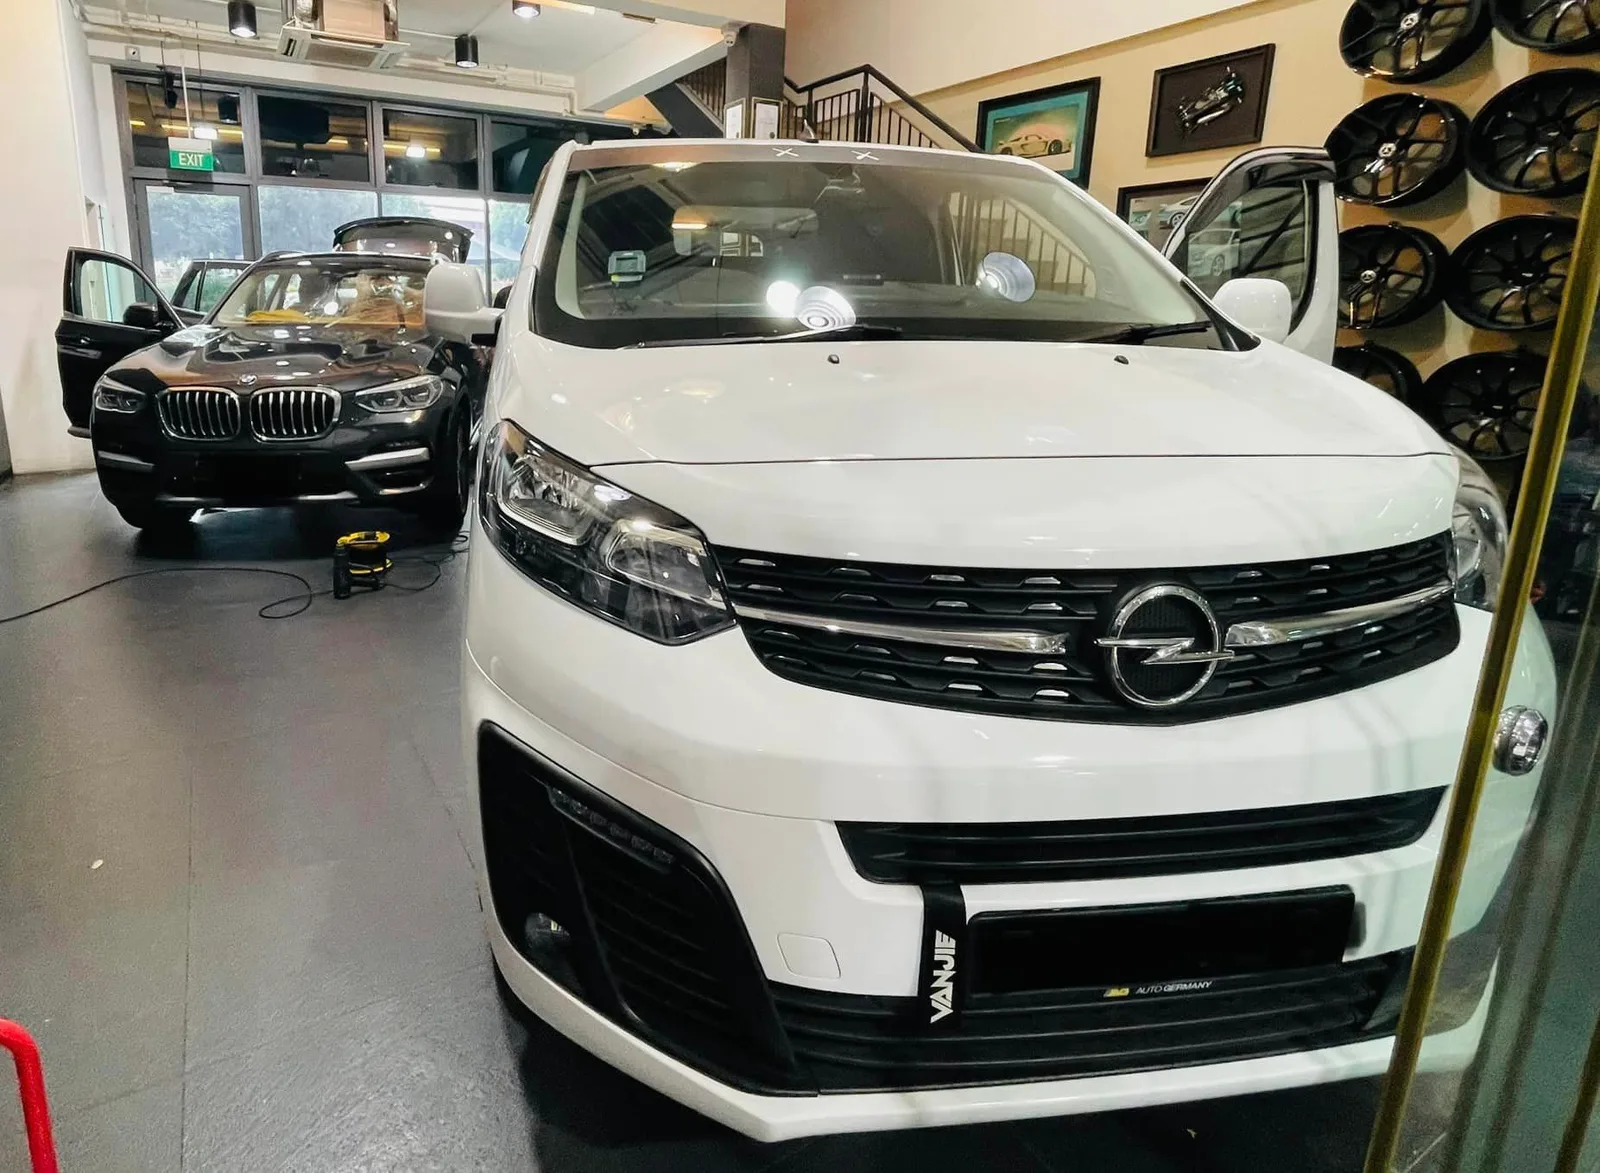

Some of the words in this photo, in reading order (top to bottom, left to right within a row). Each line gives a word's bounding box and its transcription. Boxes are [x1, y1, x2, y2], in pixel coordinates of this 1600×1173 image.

[178, 152, 204, 167] EXIT
[929, 929, 957, 1023] VANJIE
[1135, 986, 1162, 994] AUTO
[1163, 981, 1212, 992] GERMANY
